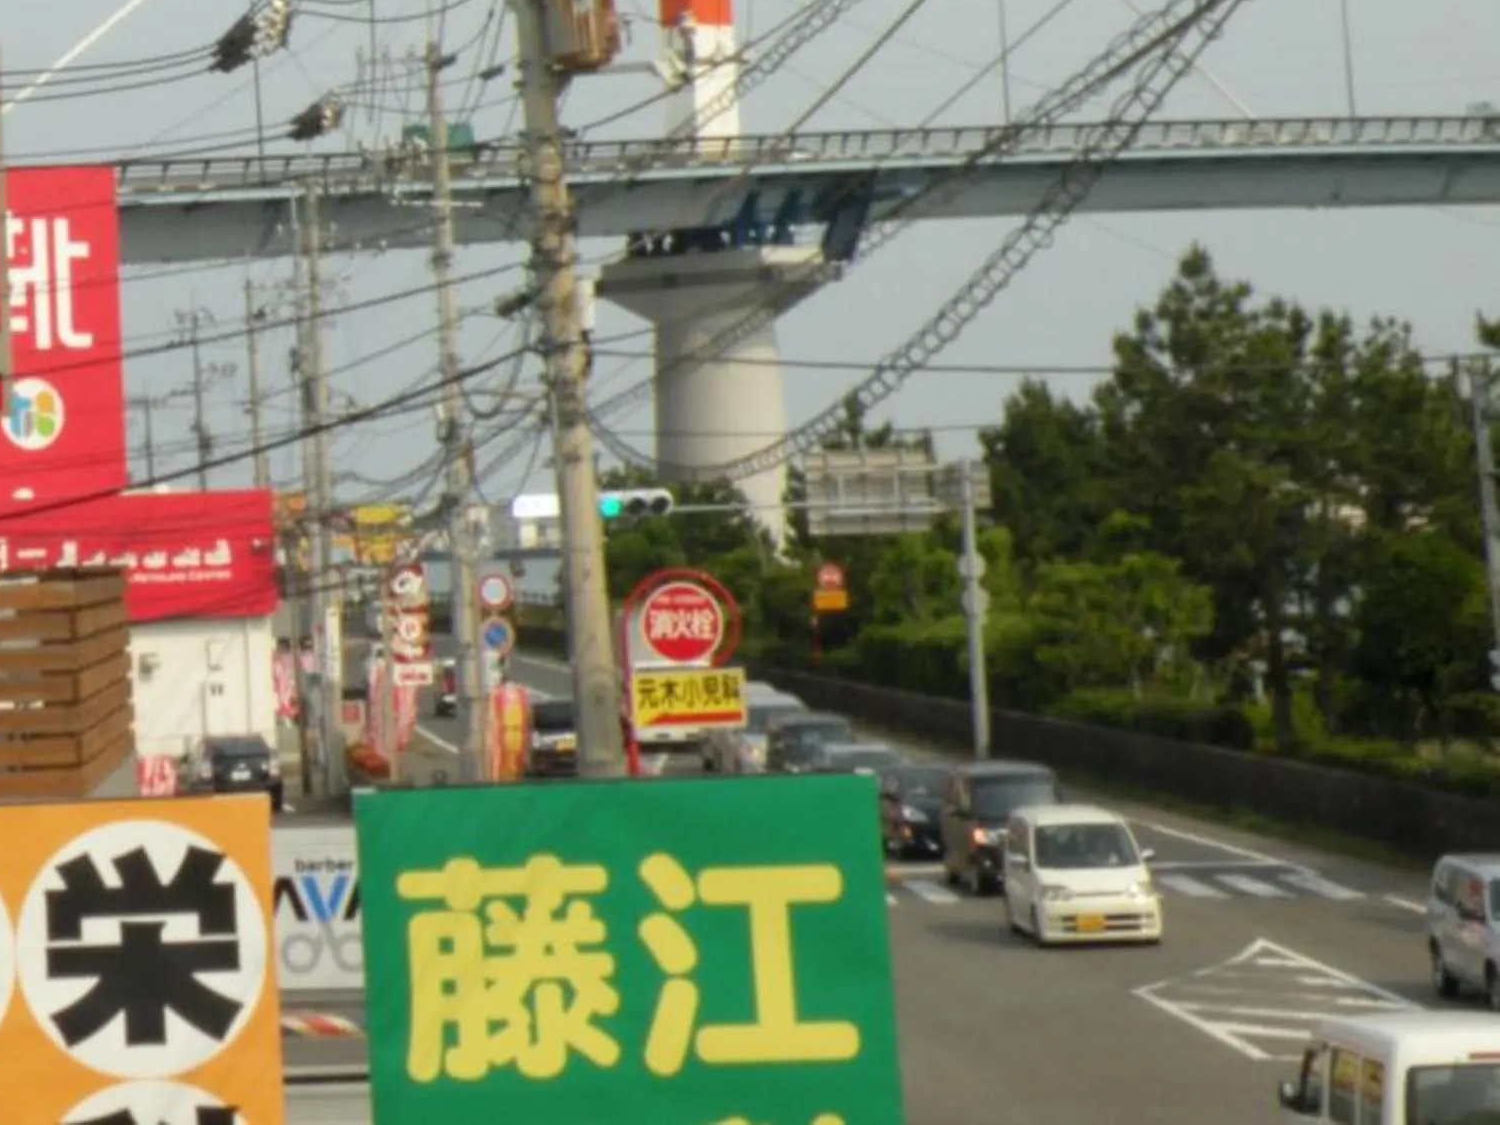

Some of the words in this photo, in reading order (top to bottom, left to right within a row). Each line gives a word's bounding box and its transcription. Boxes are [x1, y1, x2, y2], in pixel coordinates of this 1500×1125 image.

[649, 608, 715, 640] 消火栓
[395, 851, 861, 1084] 藤江
